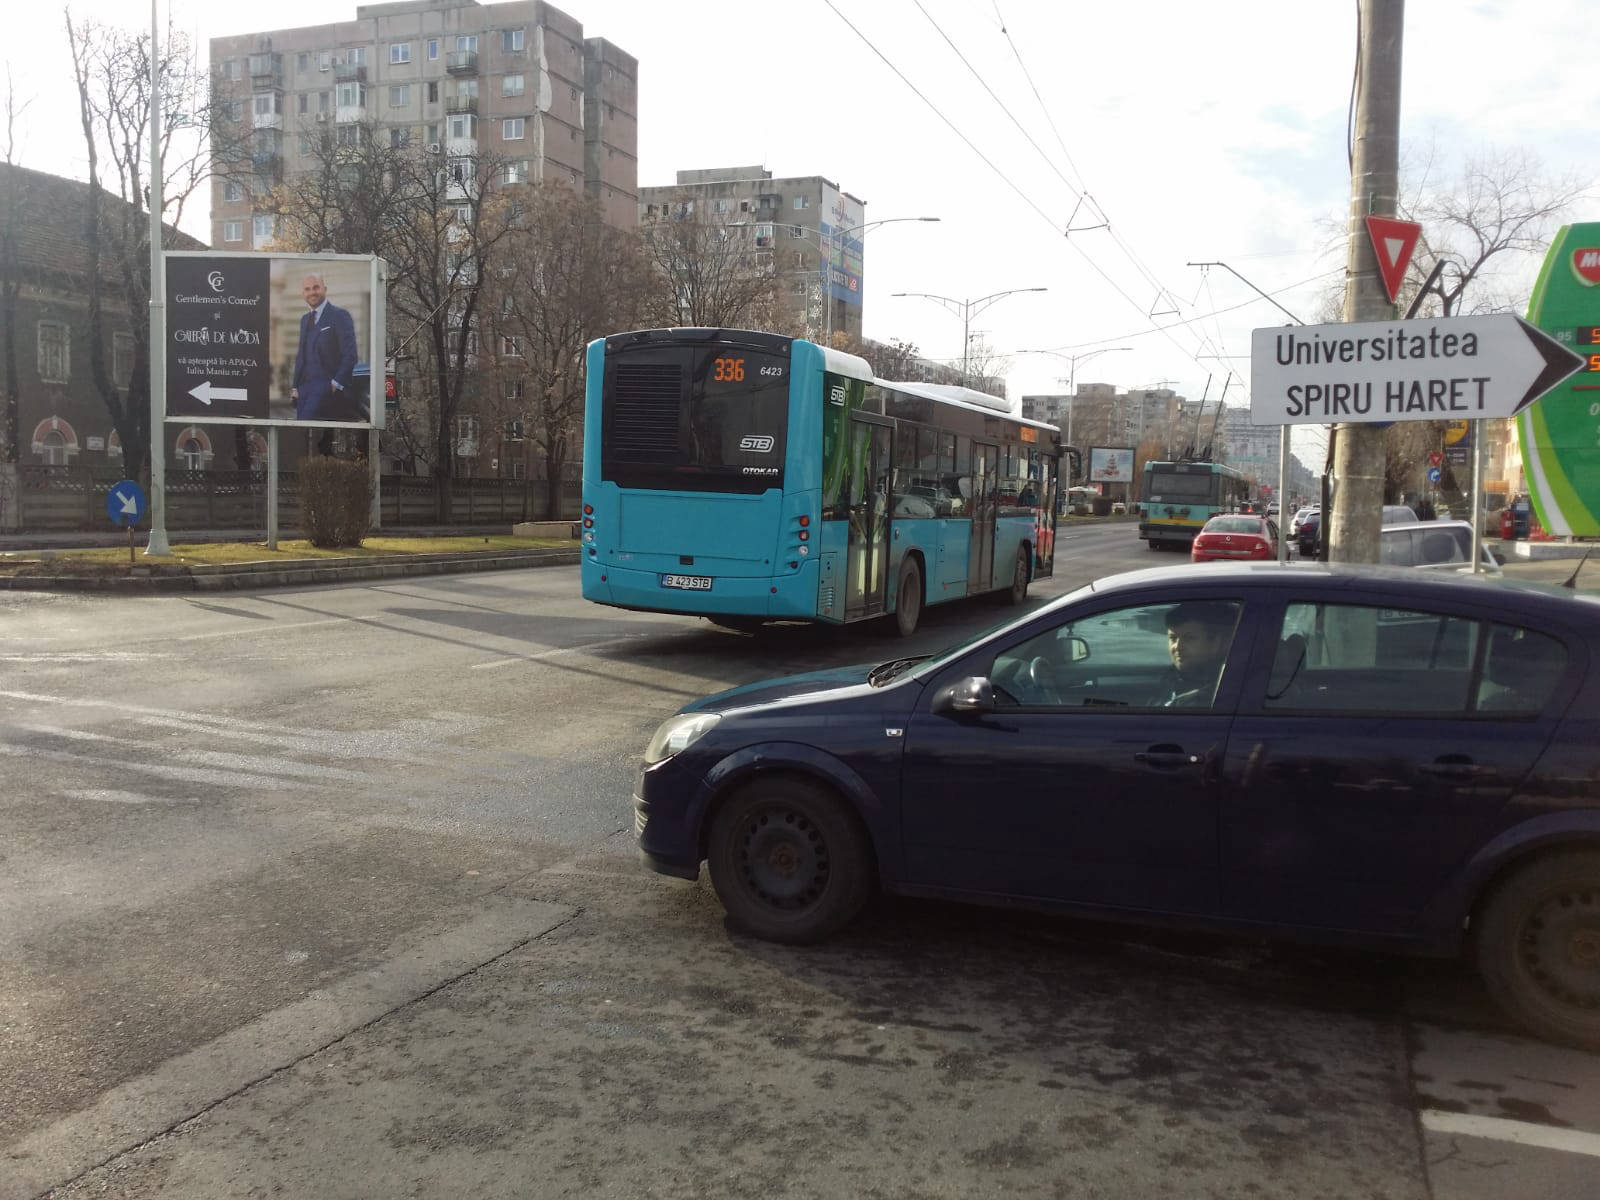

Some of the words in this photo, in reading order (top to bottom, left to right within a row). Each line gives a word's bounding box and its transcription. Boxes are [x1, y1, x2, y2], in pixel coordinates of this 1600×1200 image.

[175, 294, 227, 304] Gentlemen's
[213, 331, 226, 344] DE
[1276, 327, 1479, 366] Universitatea
[713, 358, 745, 382] 336
[760, 366, 783, 377] 6423
[830, 387, 844, 403] STB
[1285, 382, 1372, 417] SPIRU
[1385, 377, 1491, 413] HARET
[740, 437, 772, 450] STB
[666, 575, 674, 586] B
[675, 577, 691, 587] 423
[691, 578, 710, 588] STB
